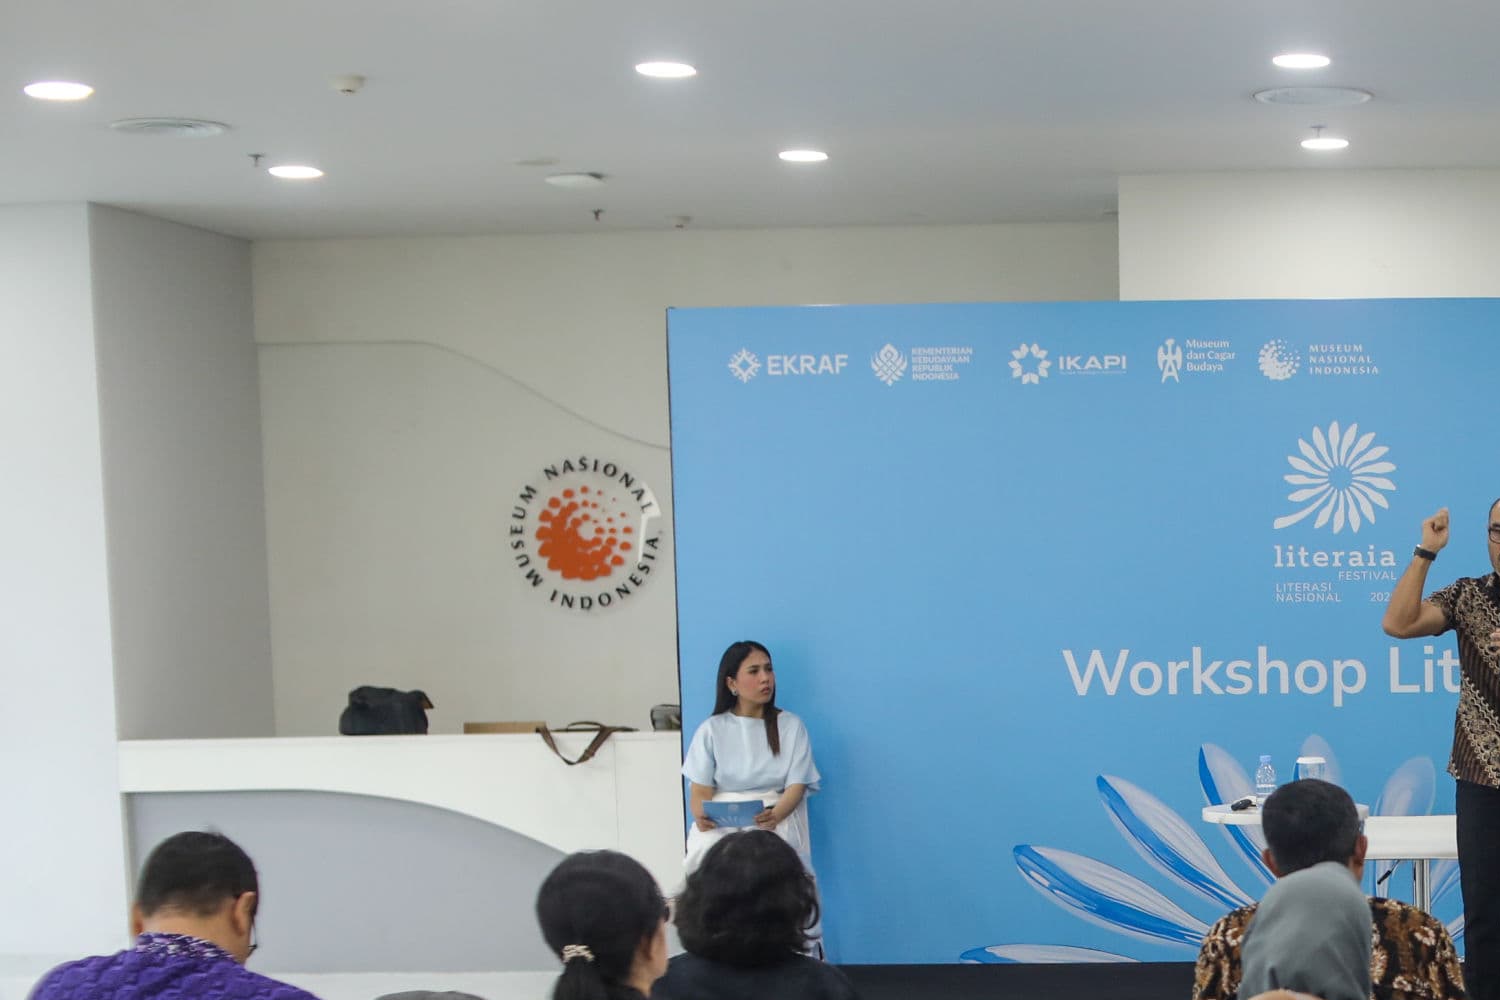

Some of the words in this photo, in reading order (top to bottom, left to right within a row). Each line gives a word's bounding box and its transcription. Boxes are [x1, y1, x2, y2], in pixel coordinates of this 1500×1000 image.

[1185, 338, 1230, 349] Museum
[1309, 343, 1363, 353] MUSEUM
[1186, 350, 1206, 360] dan
[1206, 350, 1236, 362] Cagar
[1309, 355, 1373, 364] NASIONAL
[768, 354, 848, 375] EKRAF
[1059, 355, 1127, 370] IKAPI
[1186, 359, 1225, 373] Budaya
[1309, 366, 1379, 375] INDONESIA
[544, 455, 652, 513] NASIONAL
[510, 485, 543, 587] MUSEUM
[1274, 545, 1395, 567] literaia
[550, 537, 659, 610] INDONESIA
[1338, 570, 1397, 581] FESTIVAL
[1275, 582, 1332, 592] LITERASI
[1276, 592, 1341, 603] NASIONAL
[1369, 592, 1394, 602] 202
[1063, 646, 1366, 706] Workshop
